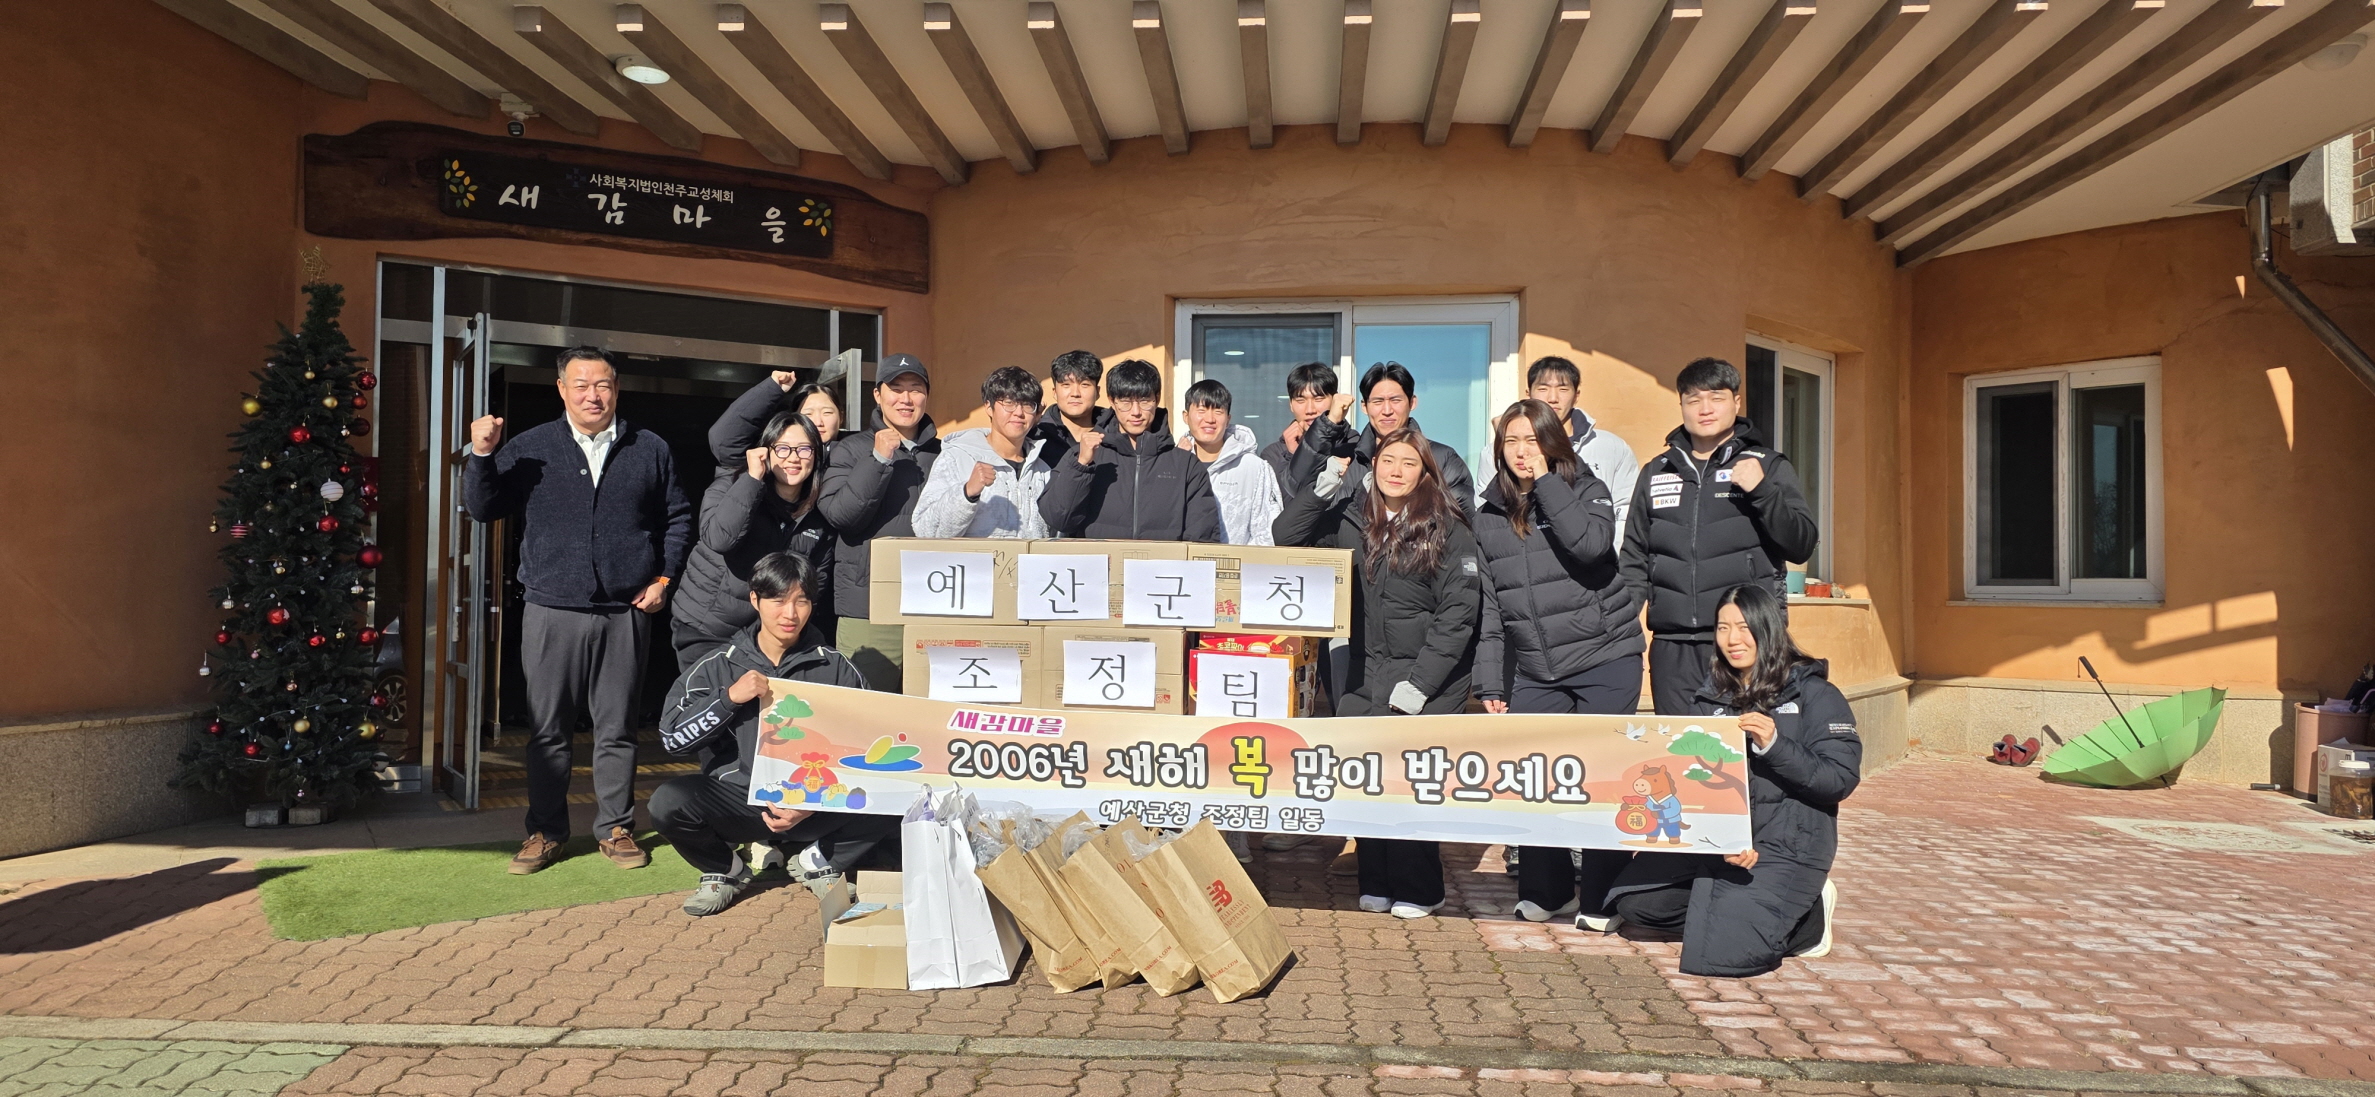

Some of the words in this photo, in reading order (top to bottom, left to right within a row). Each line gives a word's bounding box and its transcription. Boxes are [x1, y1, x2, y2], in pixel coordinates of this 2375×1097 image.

[927, 564, 965, 609] 예
[1040, 568, 1085, 613] 산
[1146, 576, 1192, 619] 군
[1266, 575, 1305, 621] 청
[952, 657, 998, 689] 조
[1088, 654, 1125, 700] 정
[1222, 670, 1258, 717] 팀
[951, 711, 1062, 735] 새감마을
[949, 739, 1088, 787] 2006년
[1104, 742, 1208, 788] 새해
[1230, 737, 1272, 798] 복
[1292, 746, 1383, 801] 많이
[1402, 747, 1590, 804] 받으세요
[1100, 800, 1190, 825] 예산군청
[1201, 805, 1268, 828] 조정팀
[1279, 808, 1324, 831] 일동
